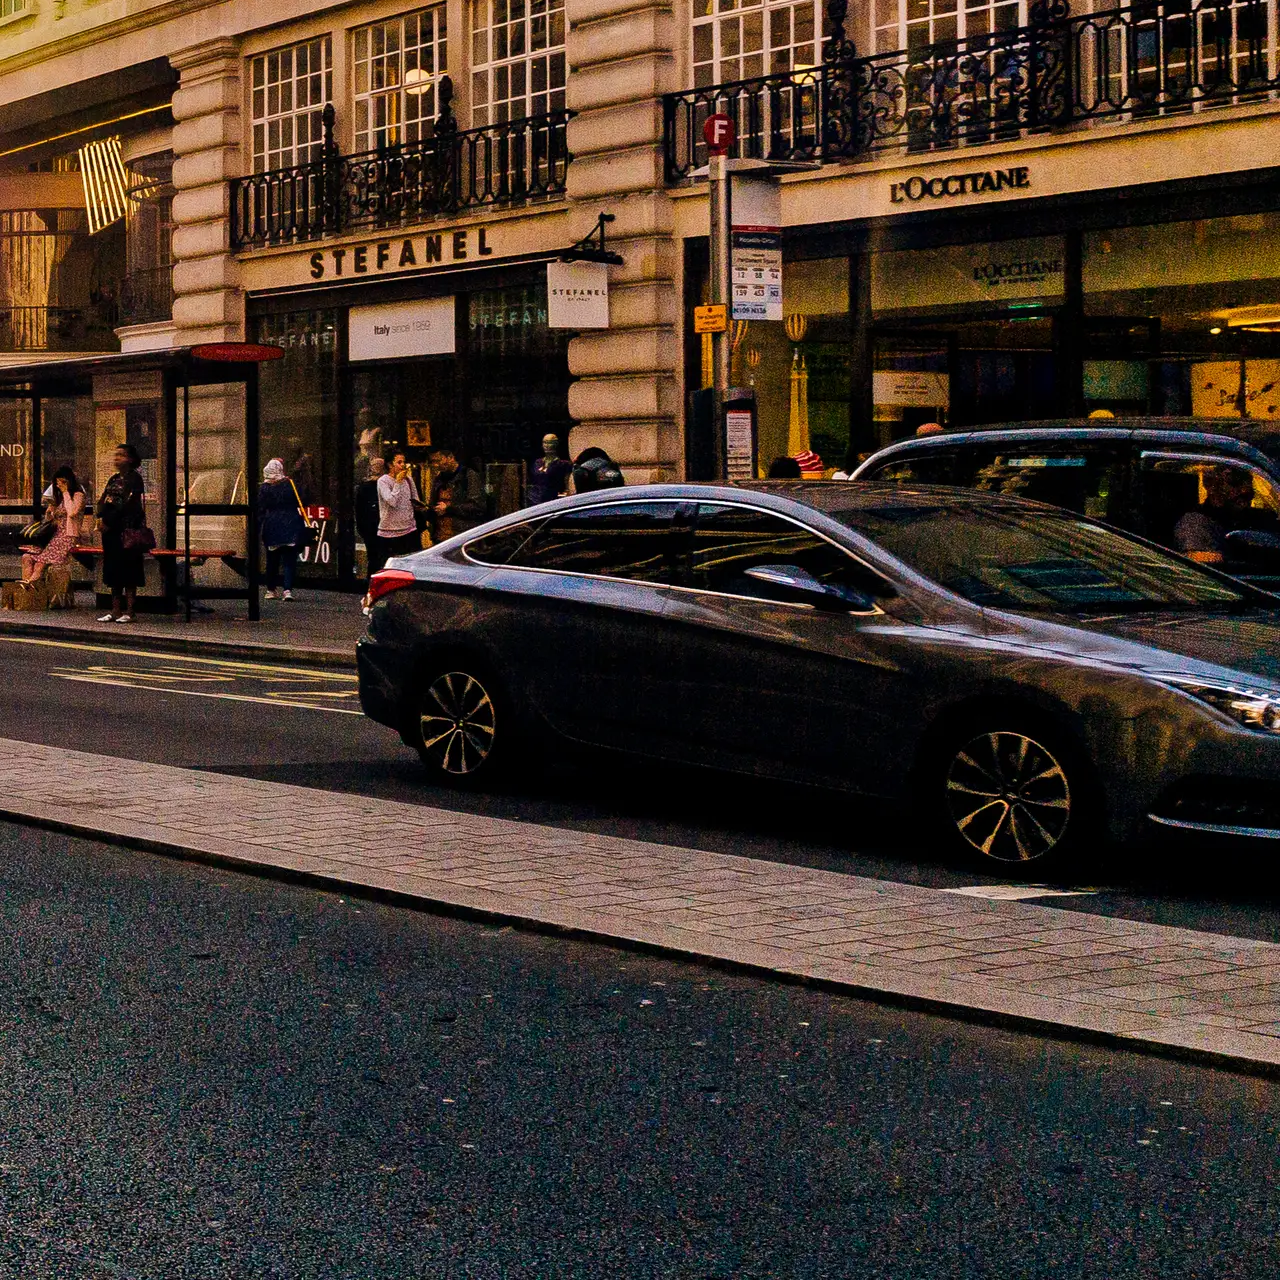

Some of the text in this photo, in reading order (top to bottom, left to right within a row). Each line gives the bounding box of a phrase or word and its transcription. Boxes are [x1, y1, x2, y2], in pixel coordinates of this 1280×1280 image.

[714, 120, 728, 144] F
[890, 166, 1031, 203] L'OCCITANE
[310, 228, 493, 279] STEFANEL
[374, 324, 391, 336] Italy
[469, 309, 547, 330] STEFAN
